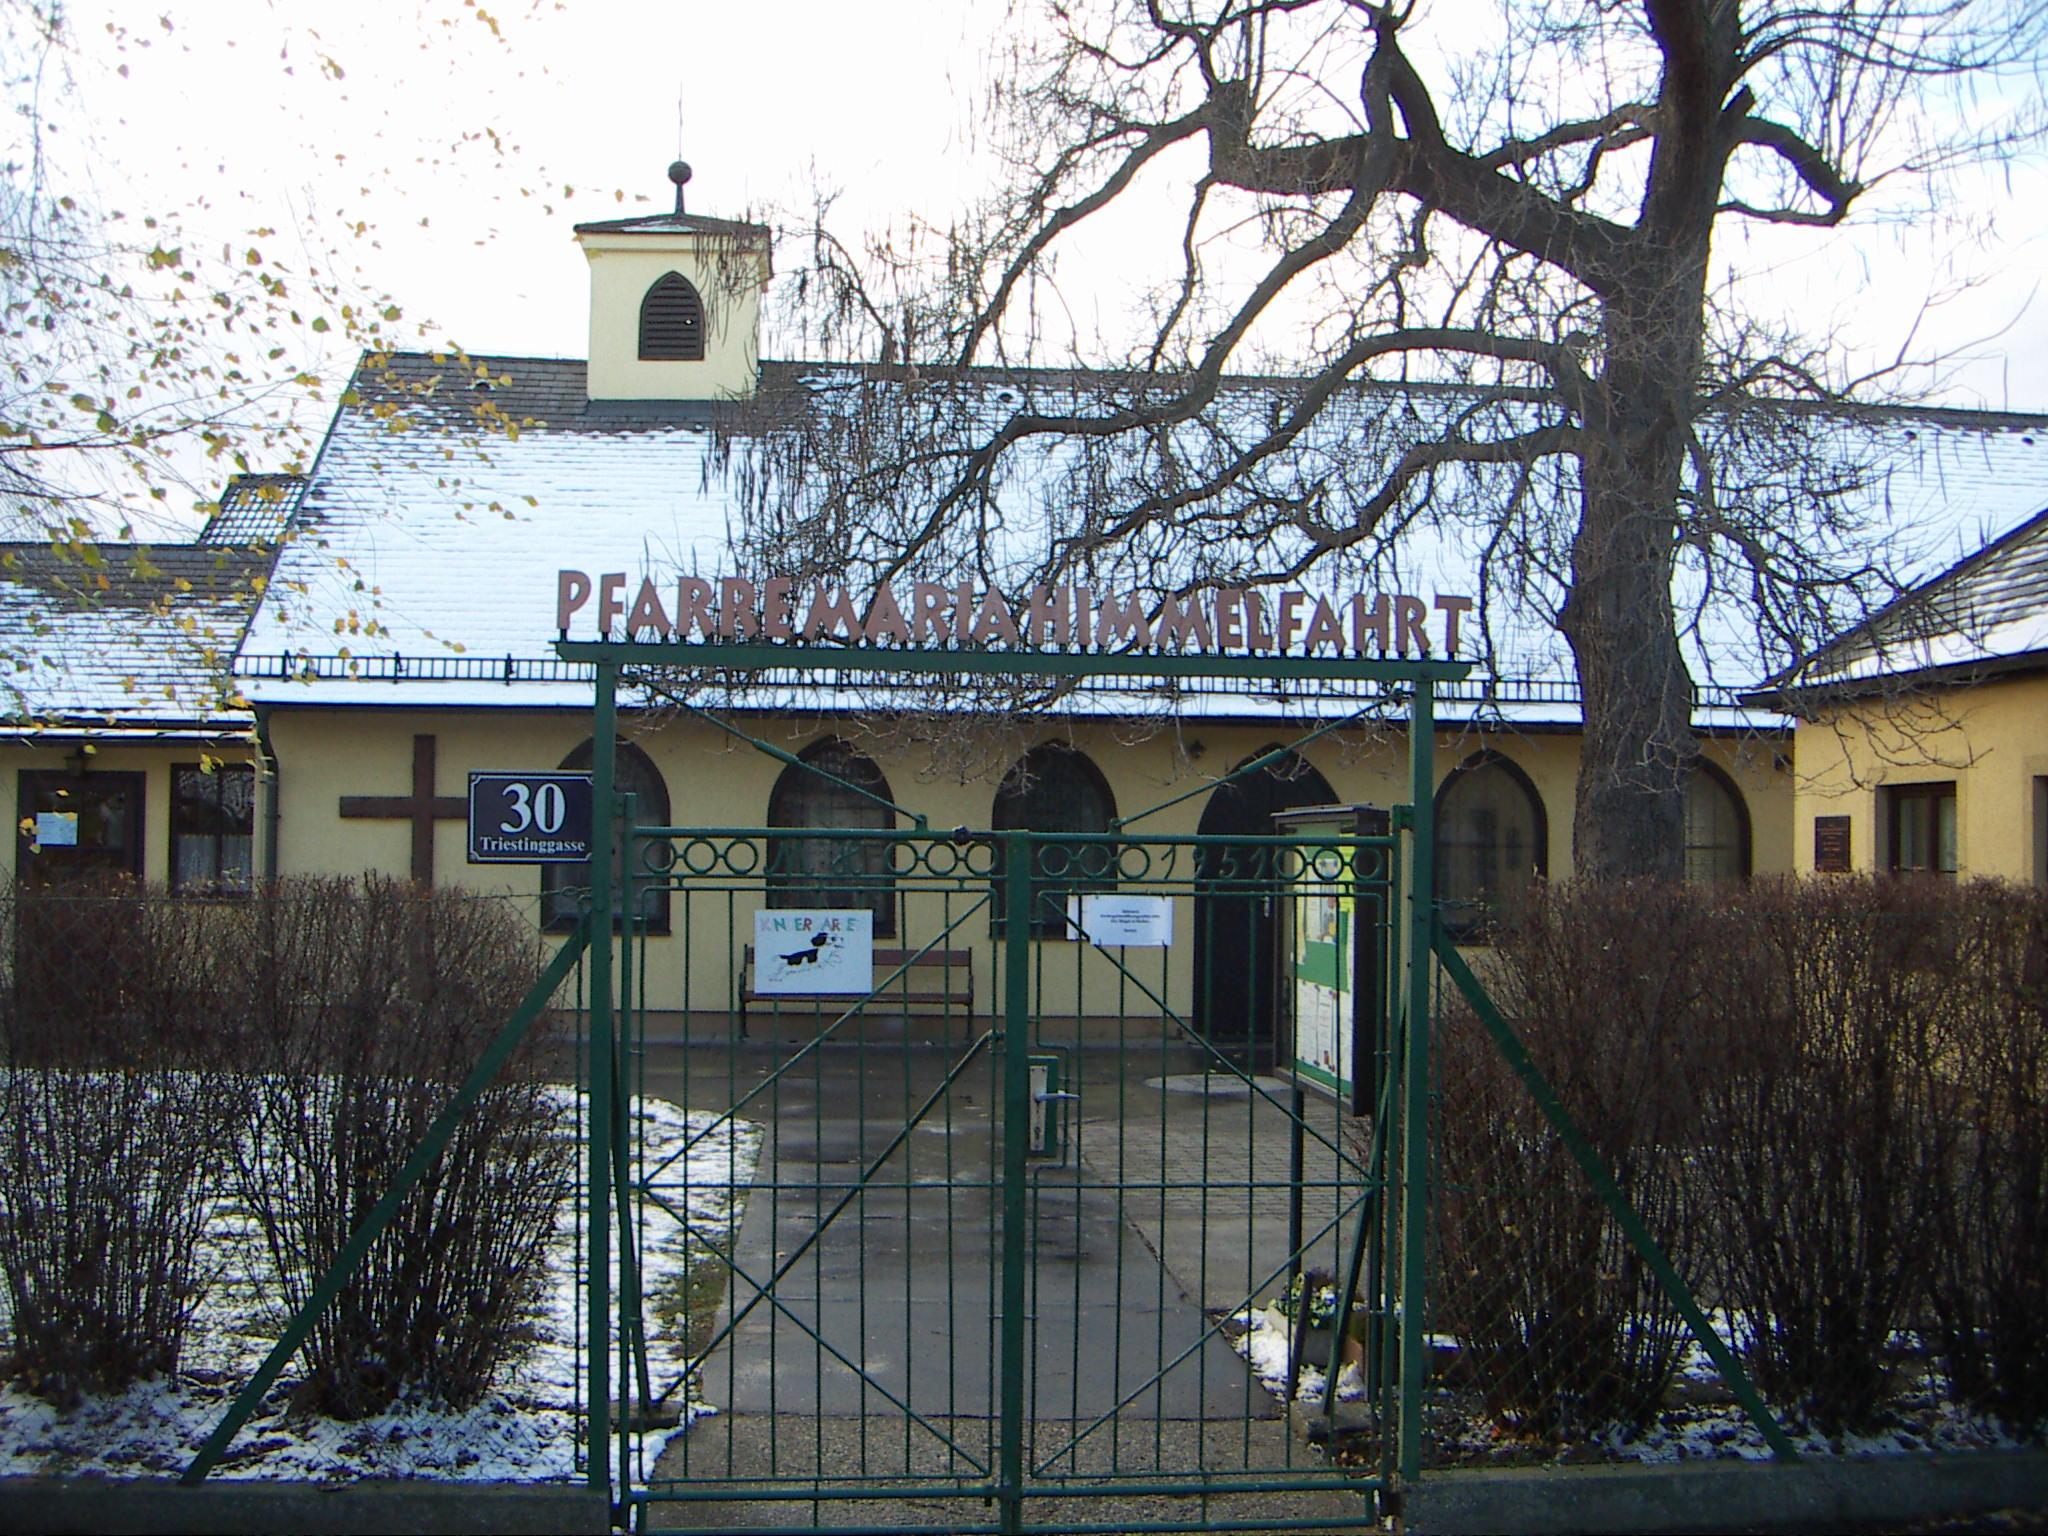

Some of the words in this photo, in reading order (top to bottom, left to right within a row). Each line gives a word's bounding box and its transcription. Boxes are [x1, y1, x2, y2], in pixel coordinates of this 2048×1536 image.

[557, 570, 792, 640] PFARRE
[803, 577, 1019, 648] MARIA
[1030, 583, 1473, 654] HIMMELFAHRT
[500, 782, 566, 833] 30
[480, 836, 586, 854] Triestinggasse
